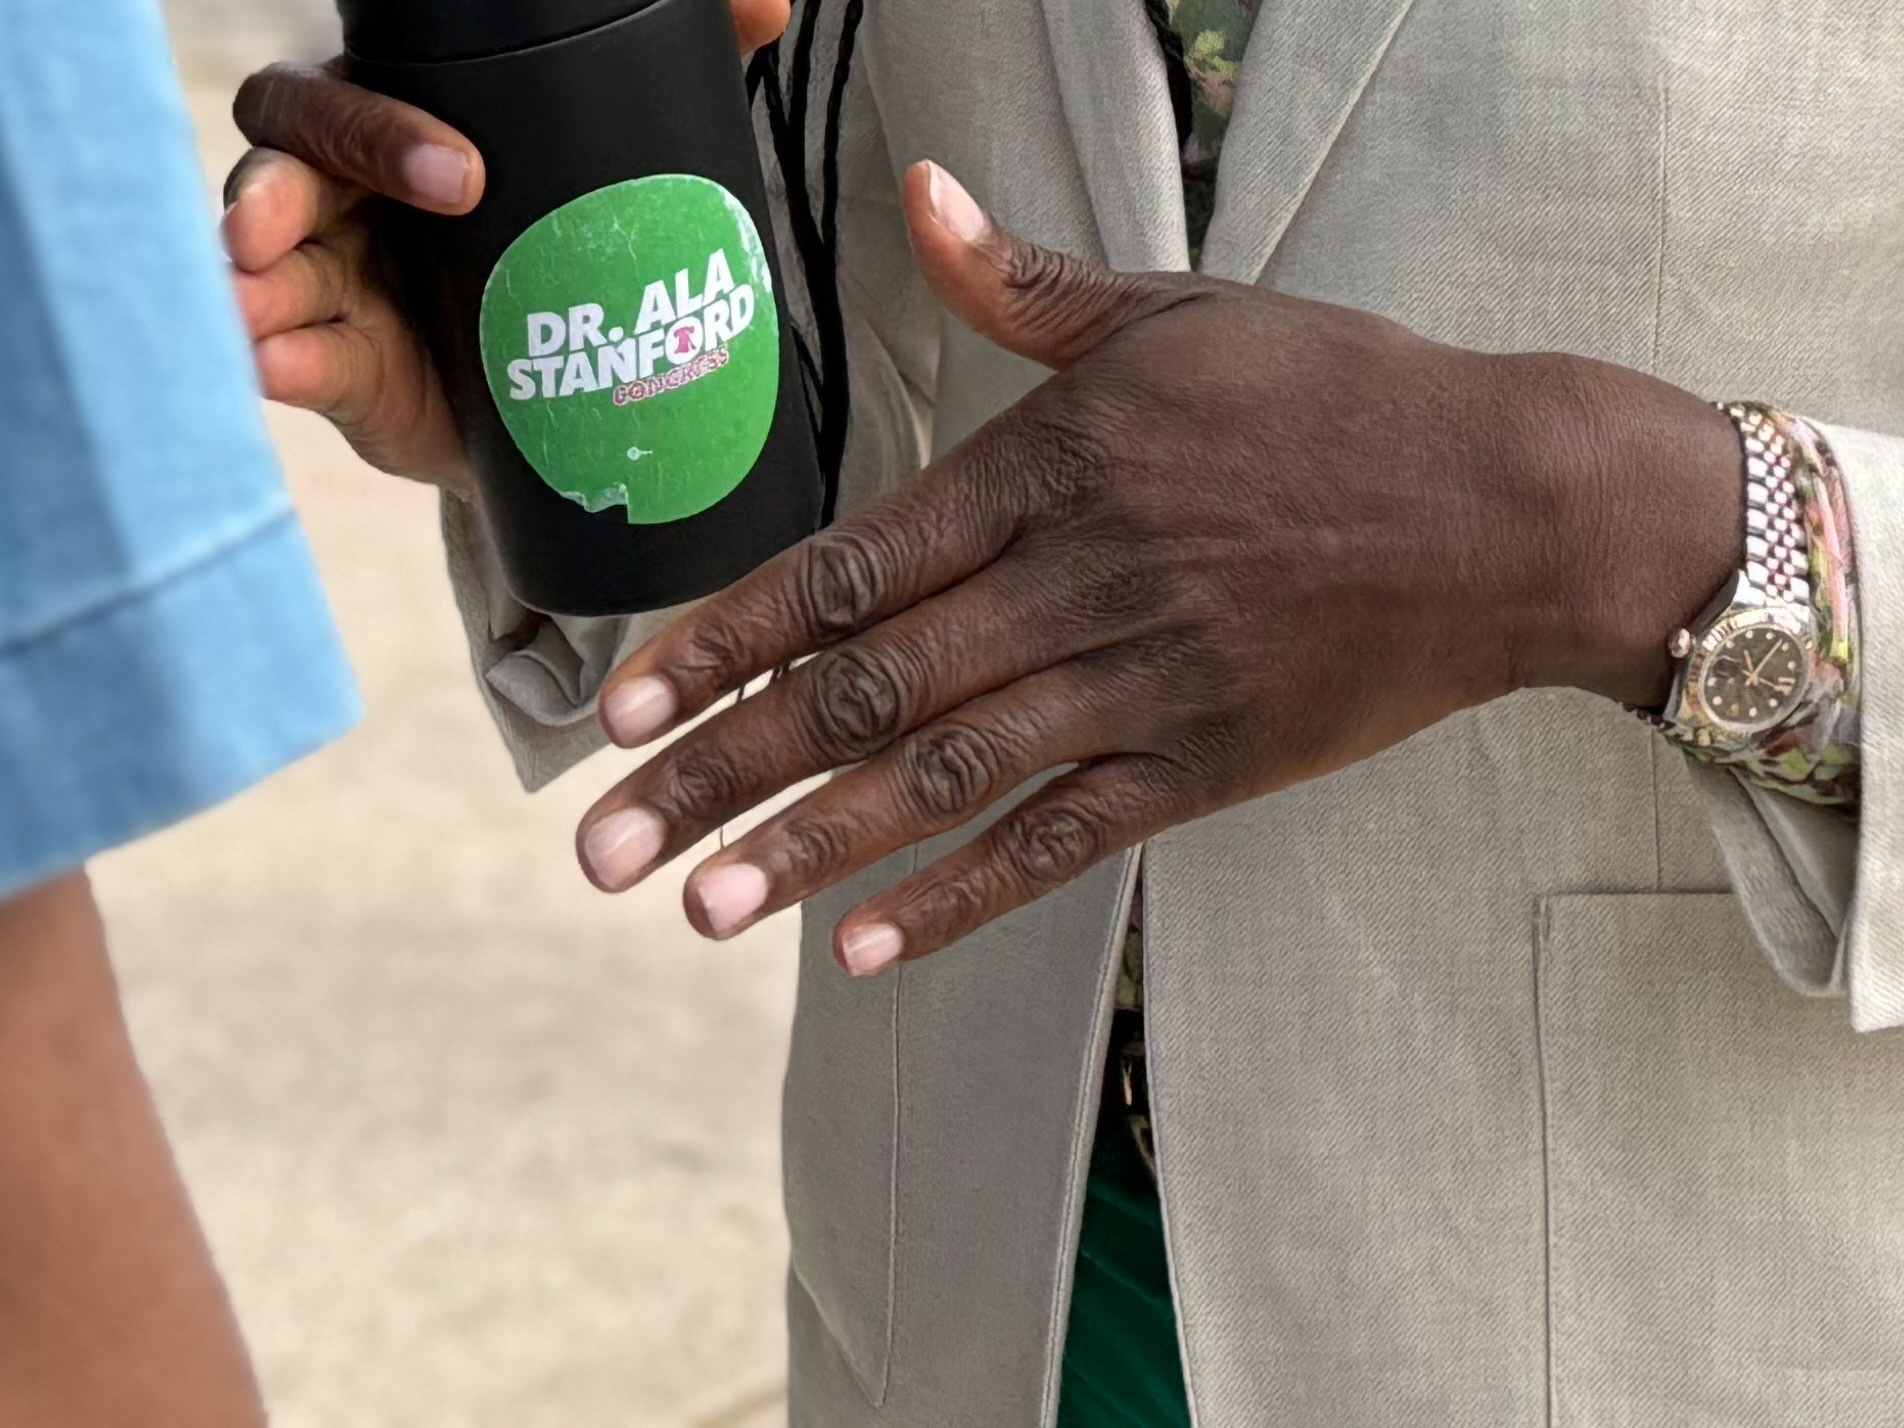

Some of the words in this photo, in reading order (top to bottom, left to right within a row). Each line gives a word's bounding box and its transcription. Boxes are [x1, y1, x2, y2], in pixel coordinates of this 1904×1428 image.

[507, 284, 755, 400] STANFORD
[527, 302, 624, 357] DR.
[634, 248, 735, 335] ALA
